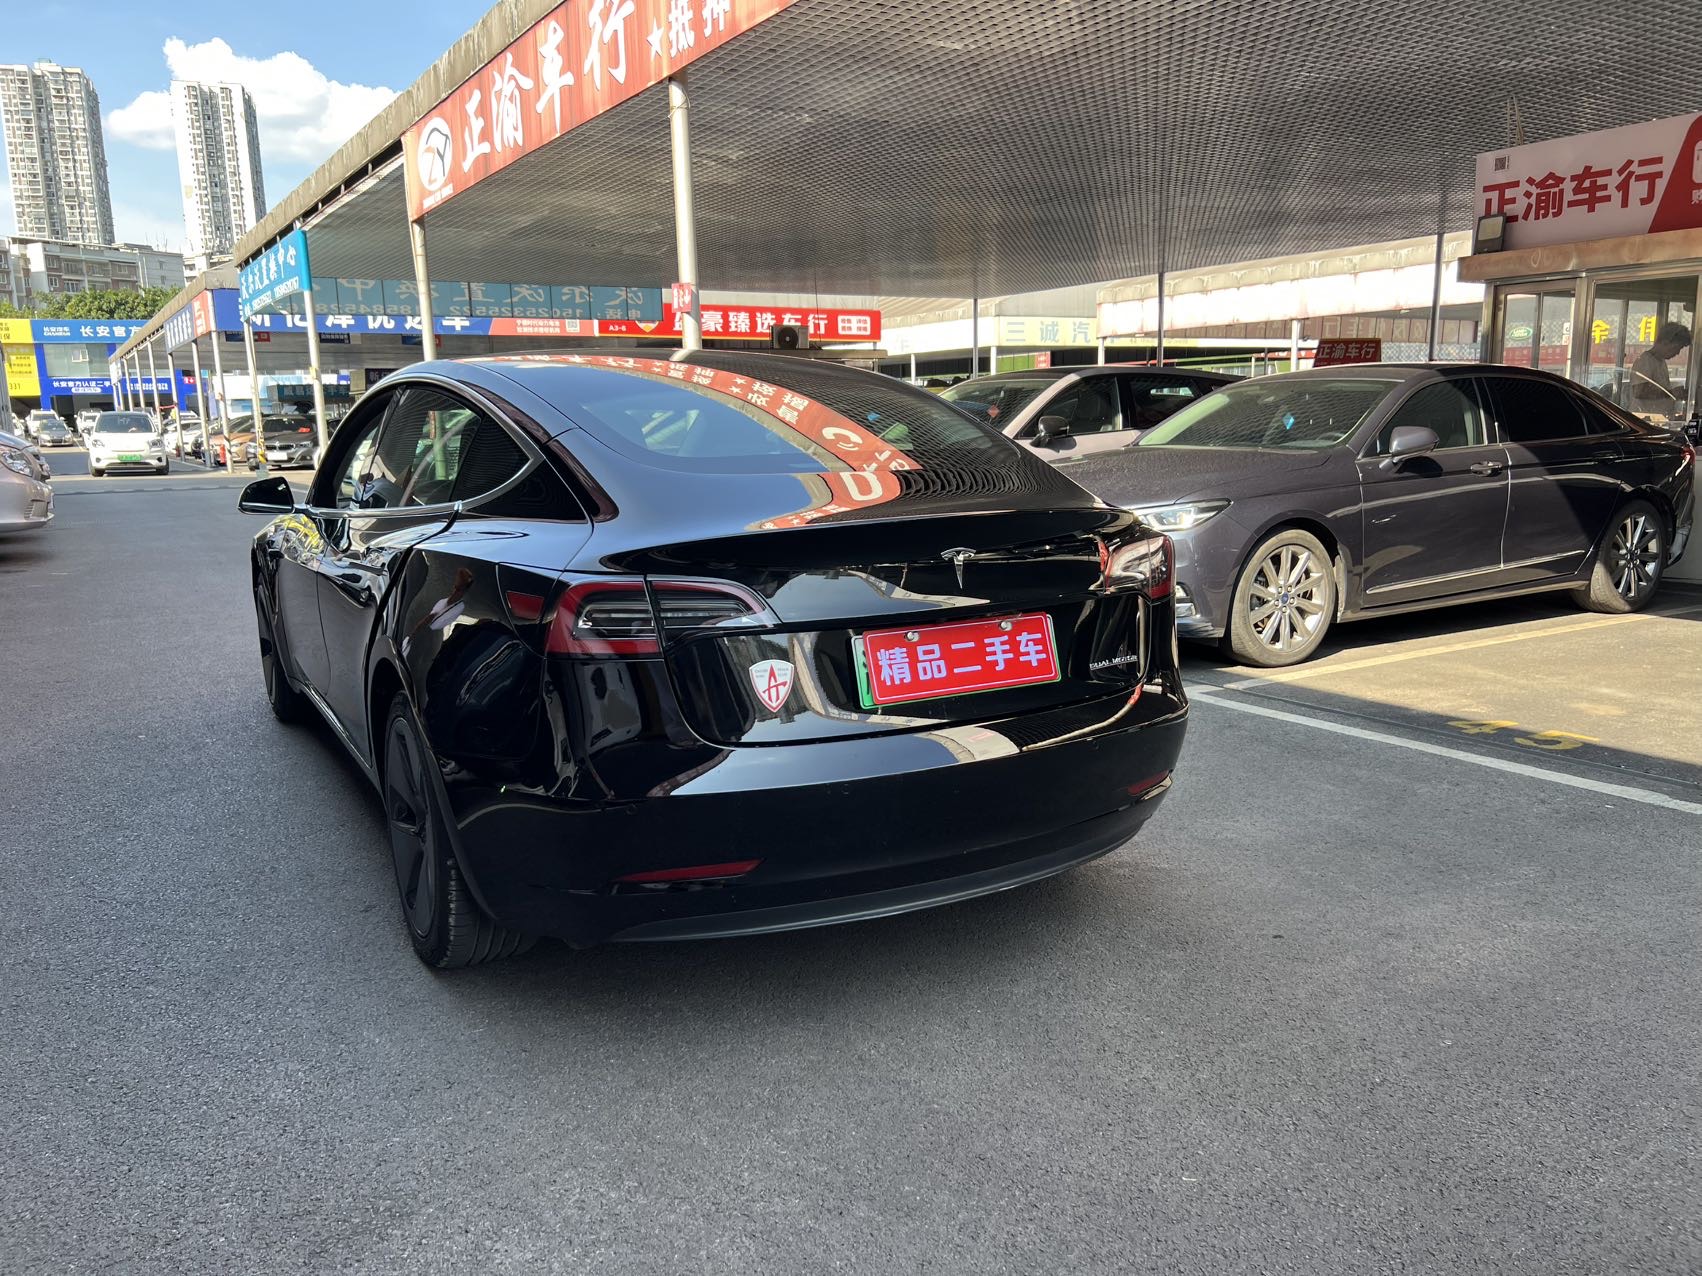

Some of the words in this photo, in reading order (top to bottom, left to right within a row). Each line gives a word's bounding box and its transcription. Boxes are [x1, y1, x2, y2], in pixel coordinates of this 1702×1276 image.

[461, 0, 636, 174] 正渝车行
[1482, 155, 1664, 225] 正渝车行
[1006, 321, 1118, 345] 三诚汽
[1317, 342, 1376, 359] 正渝车行
[876, 630, 1047, 687] 精品二手车
